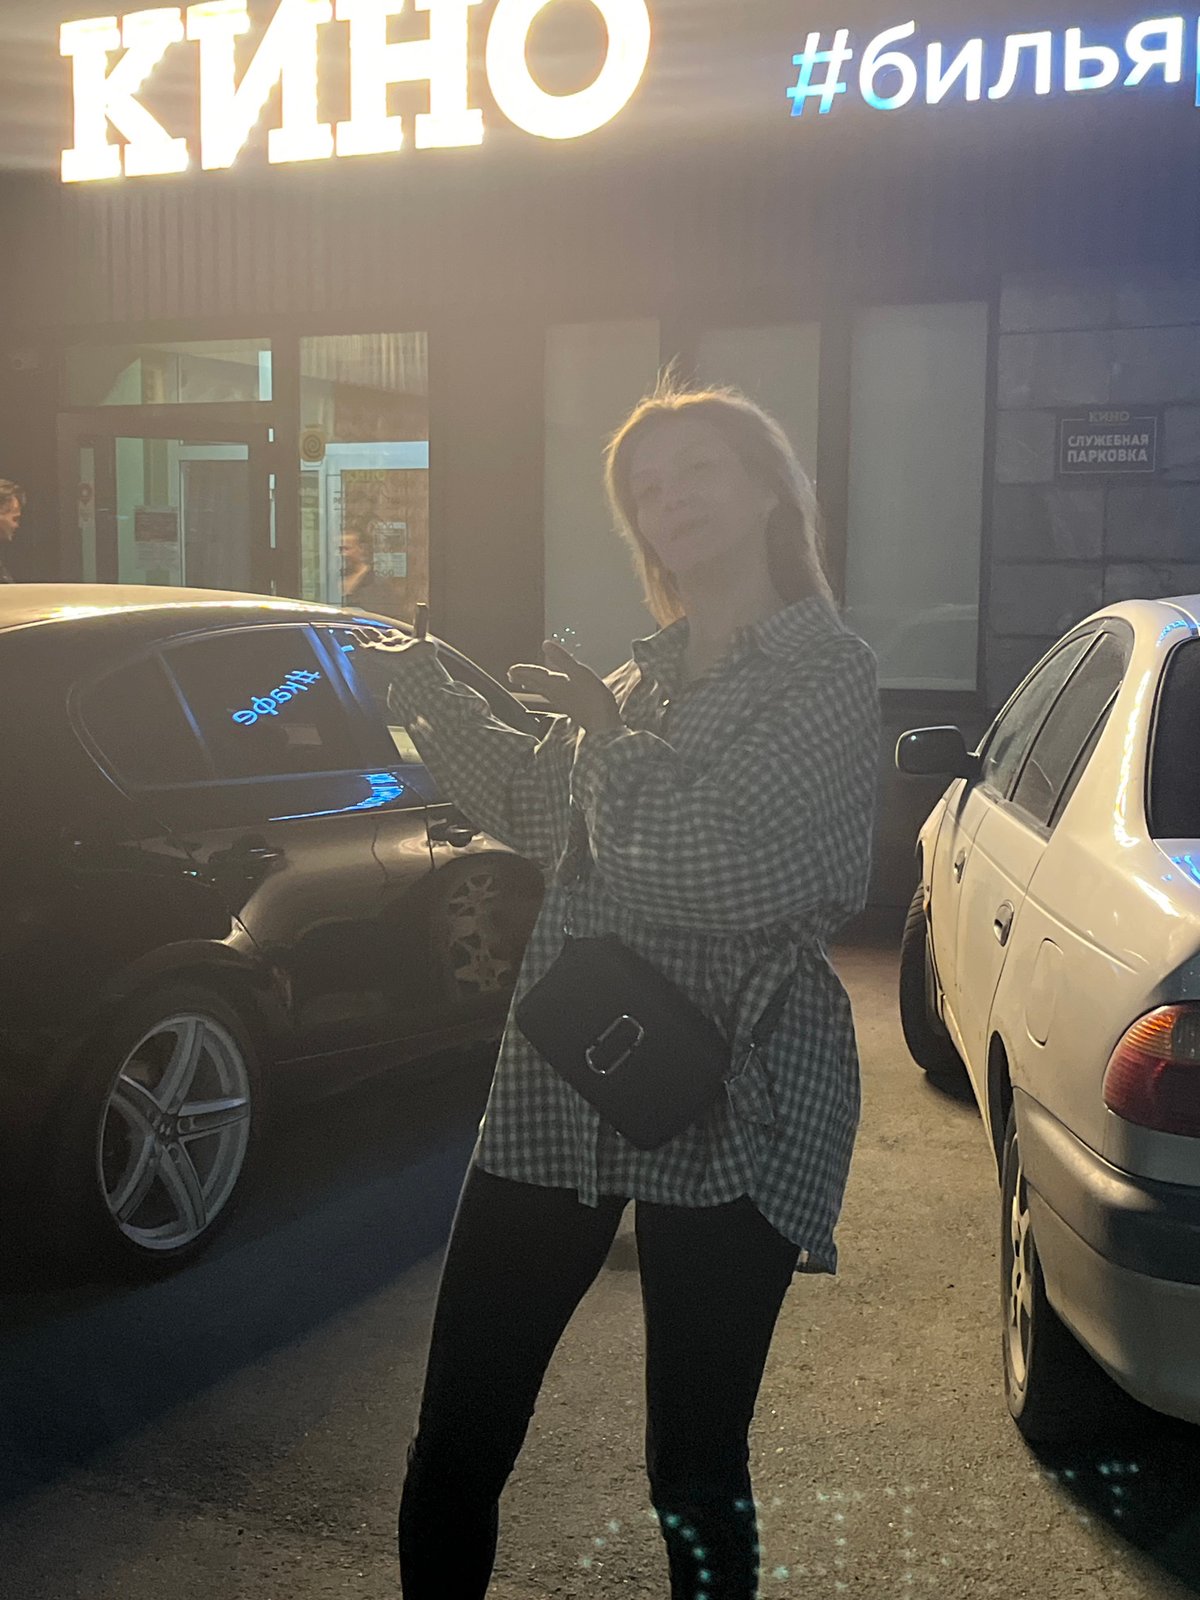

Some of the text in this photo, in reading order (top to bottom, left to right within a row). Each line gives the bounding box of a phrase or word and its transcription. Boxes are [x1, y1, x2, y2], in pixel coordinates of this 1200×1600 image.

[786, 14, 1200, 117] #билья
[59, 0, 651, 184] КИНО
[1088, 410, 1130, 422] КИНО
[1067, 434, 1149, 447] СЛУЖЕБНАЯ
[1067, 448, 1148, 463] ПАРКОВКА
